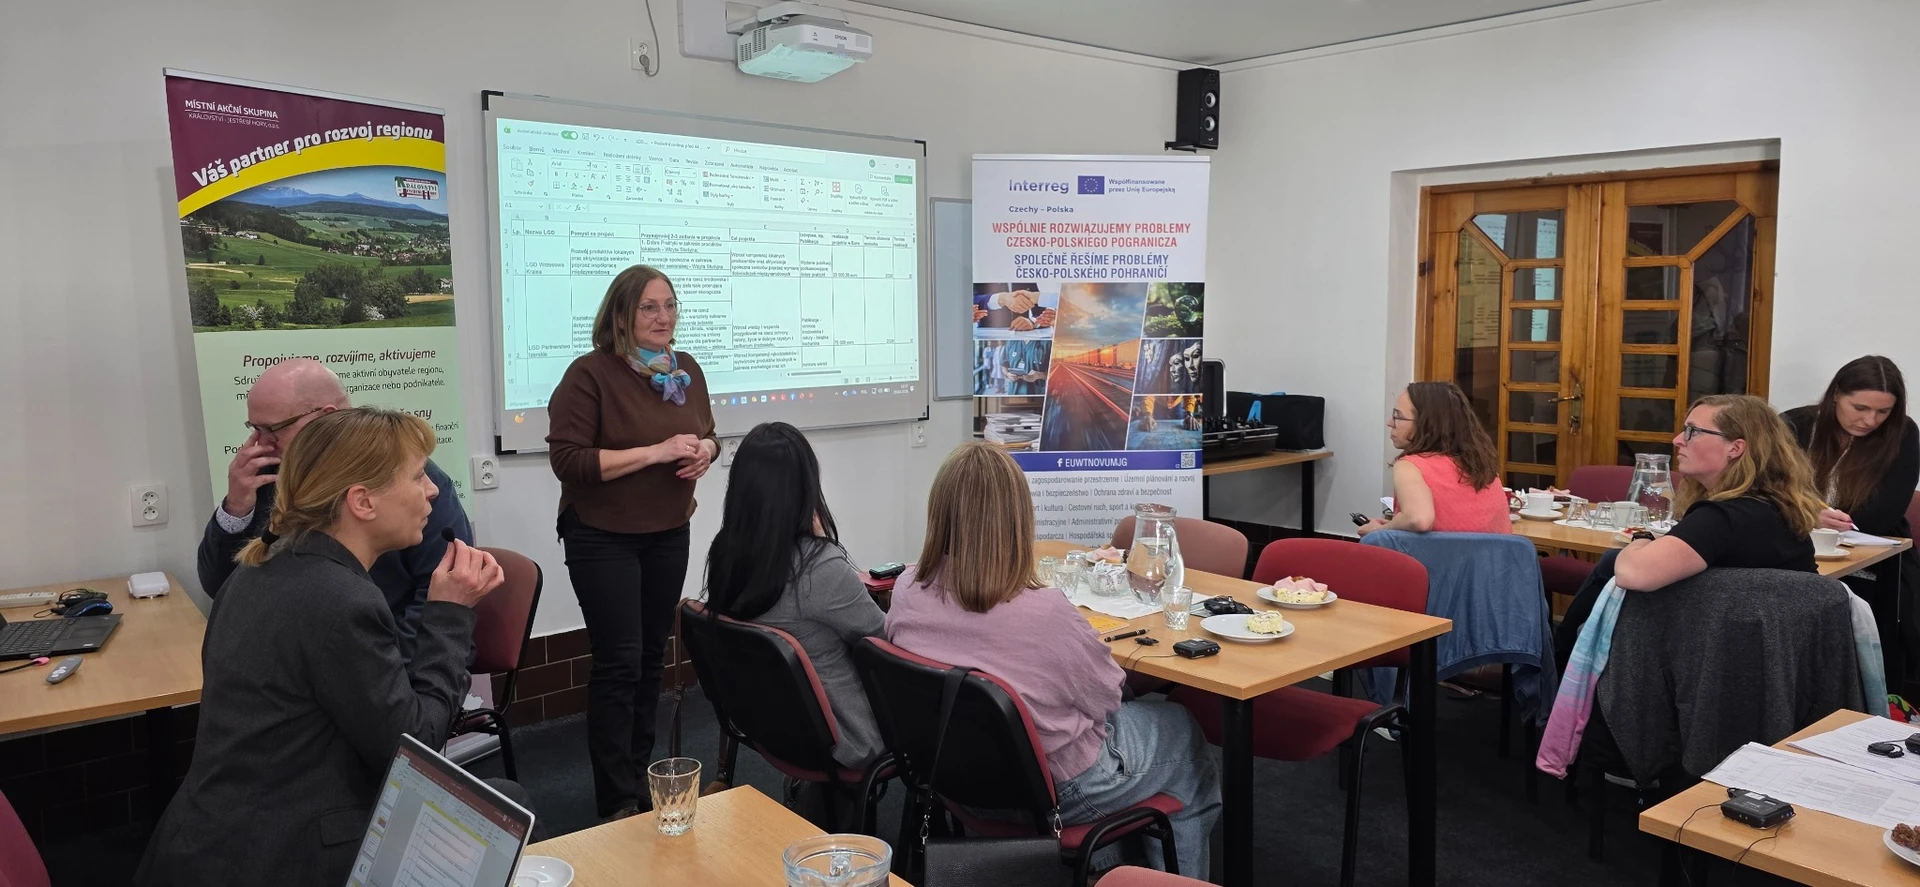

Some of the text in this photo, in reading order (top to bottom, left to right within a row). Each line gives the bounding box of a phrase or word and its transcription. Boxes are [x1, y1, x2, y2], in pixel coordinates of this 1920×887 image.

[185, 98, 278, 118] MÍSTNÍ AKČNÍ SKUPINA
[192, 121, 433, 187] Váš partner pro rozvoj regionu
[1009, 179, 1069, 194] Interreg
[992, 220, 1191, 236] WSPÓLNIE ROZWIĄZUJEMY PROBLEMY
[1006, 237, 1177, 247] CZESKO-POLSKIEGO POGRANICZA
[1014, 252, 1169, 265] SPOLEČNĚ ŘEŠÍME PROBLÉMY
[1016, 265, 1168, 279] ČESKO-POLSKÉHO POHRANIČÍ
[243, 349, 436, 369] Propoje, rozvíjíme, aktivujeme
[352, 368, 377, 378] aktivní
[378, 367, 415, 378] obyvatele
[418, 366, 444, 375] regionu,
[346, 378, 445, 394] rganizace nebo podnikatele.
[414, 410, 432, 420] sny
[1065, 458, 1128, 467] EUWTNOVUMJG
[1032, 476, 1082, 485] zagospodarowanie
[1084, 475, 1119, 484] przestrzenne
[1146, 475, 1173, 484] plánování
[1141, 488, 1172, 496] bezpečnost
